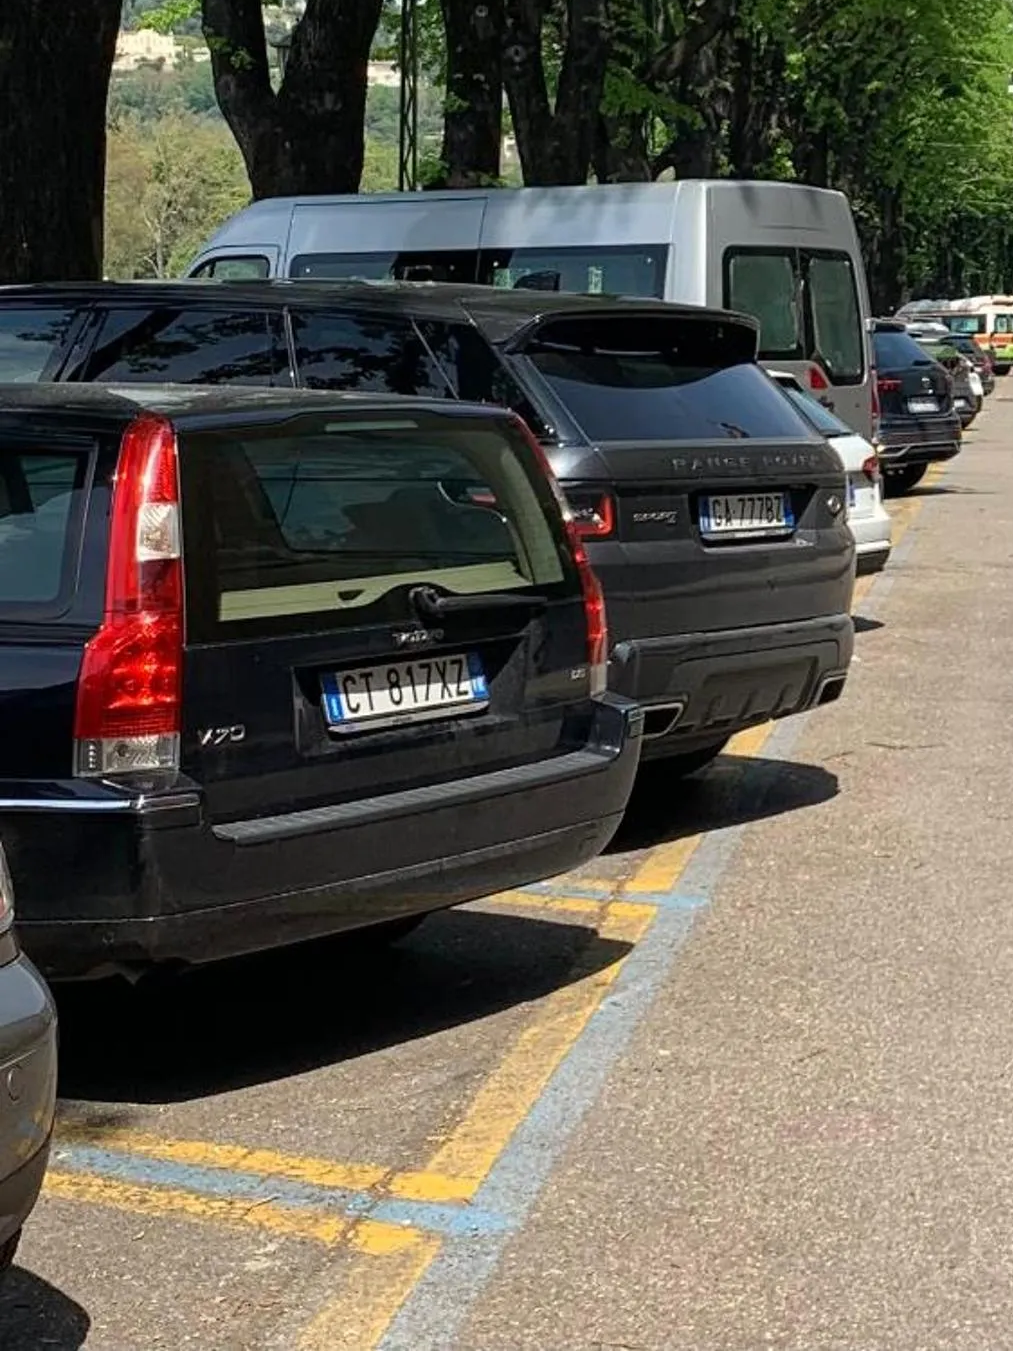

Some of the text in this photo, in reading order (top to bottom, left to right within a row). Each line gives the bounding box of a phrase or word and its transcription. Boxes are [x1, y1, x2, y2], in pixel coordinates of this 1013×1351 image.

[342, 659, 468, 713] CT 817XZ
[197, 724, 245, 746] V70
